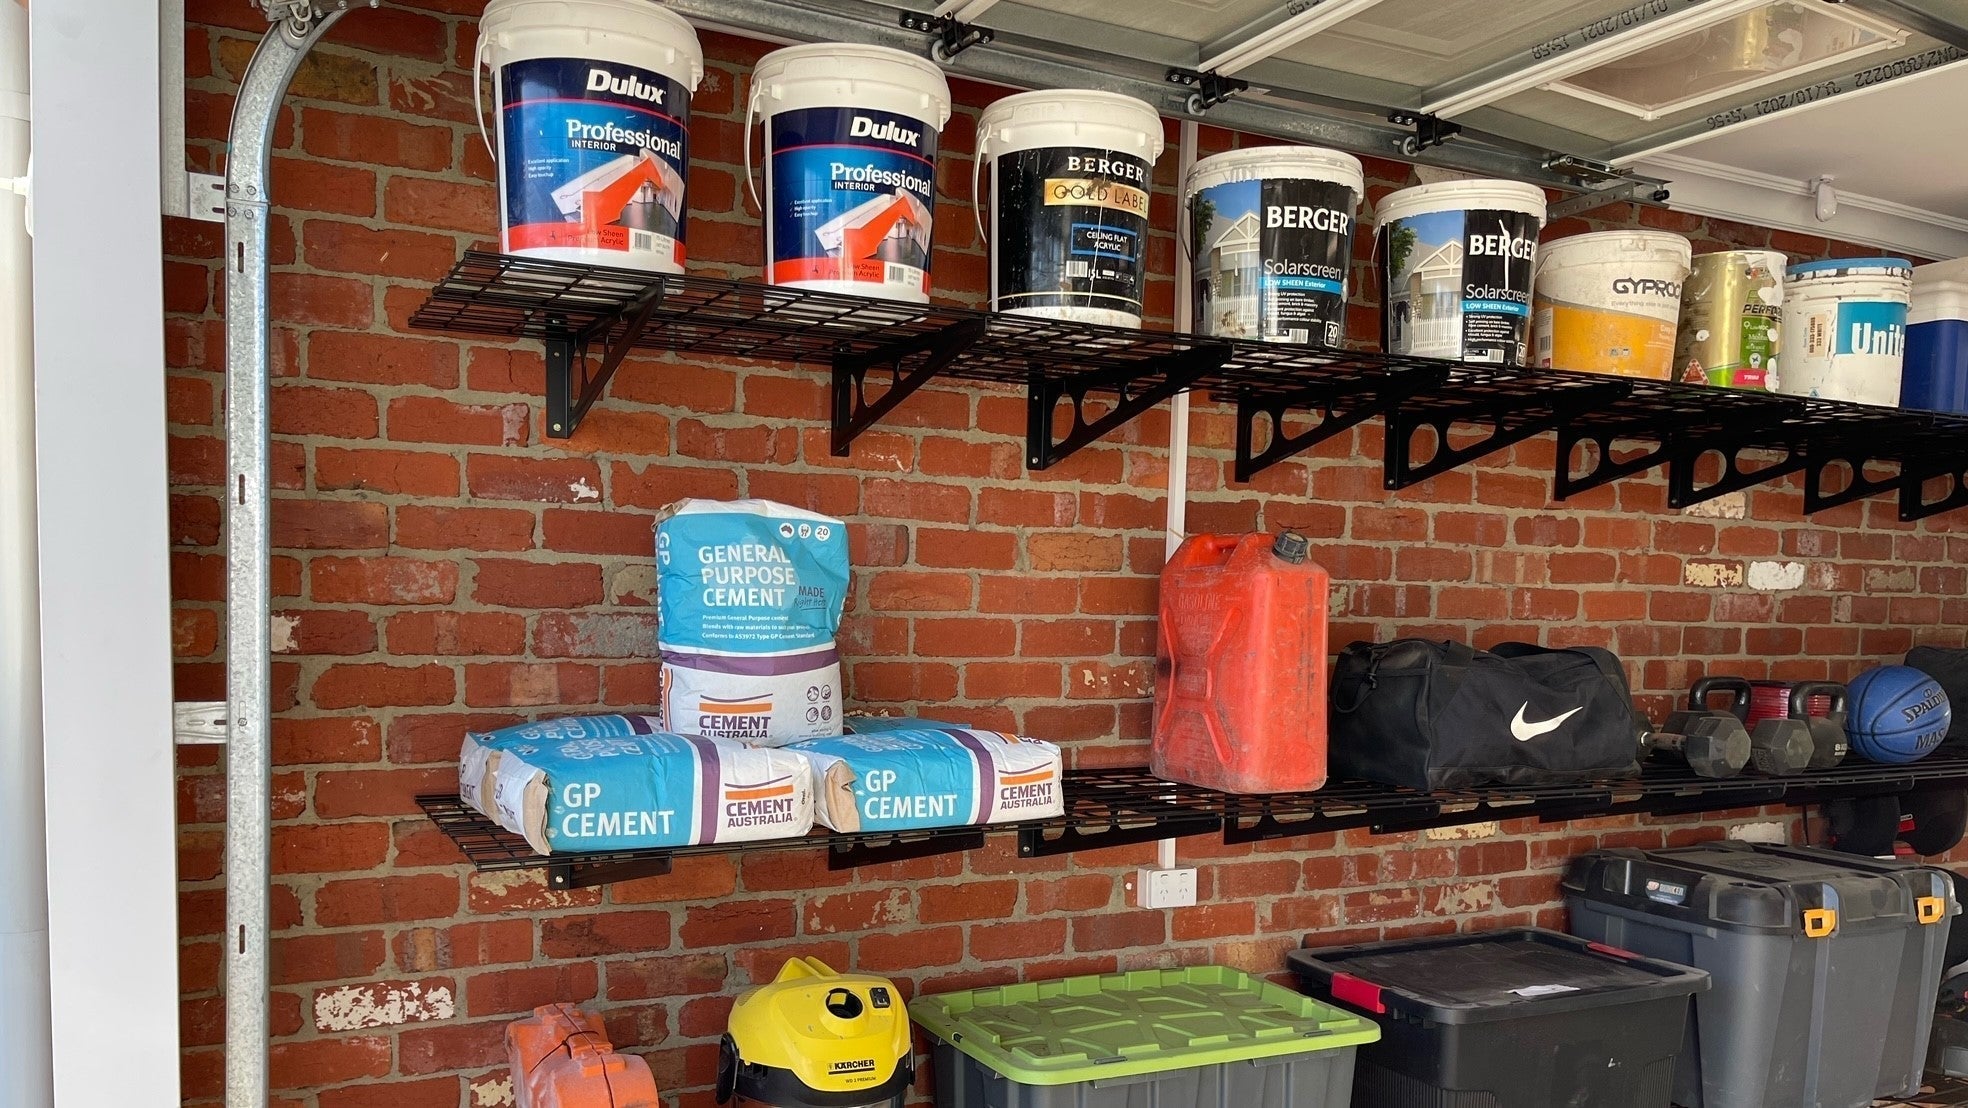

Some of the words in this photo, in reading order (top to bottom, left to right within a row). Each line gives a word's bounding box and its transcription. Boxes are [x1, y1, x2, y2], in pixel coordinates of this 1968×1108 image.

[586, 68, 664, 105] Dulux
[566, 118, 681, 160] Professional
[850, 116, 919, 147] Dulux
[571, 139, 617, 152] INTERIOR
[1067, 156, 1144, 183] BERGER
[830, 162, 931, 198] Professional
[834, 181, 876, 192] INTERIOR
[1053, 184, 1108, 201] GOLD
[1114, 188, 1147, 214] LABEL
[1266, 205, 1349, 236] BERGER
[601, 236, 624, 246] Acrylic
[603, 229, 623, 238] Sheen
[1086, 231, 1113, 241] CEILING
[1114, 235, 1128, 243] FLAT
[1094, 241, 1121, 252] ACRYLIC
[1469, 234, 1537, 263] BERGER
[860, 263, 880, 271] Sheen
[1264, 258, 1342, 280] Solarscreen
[1264, 279, 1281, 287] LOW
[1282, 279, 1304, 287] SHEEN
[1304, 280, 1326, 289] Exterior
[1465, 283, 1530, 304] Solarscreen
[1465, 302, 1481, 310] LOW
[1482, 302, 1501, 310] SHEEN
[1501, 304, 1519, 312] Exterior
[1328, 324, 1338, 338] 20
[817, 527, 829, 536] 20
[657, 531, 671, 566] GP
[698, 544, 791, 564] GENERAL
[701, 566, 796, 586] PURPOSE
[703, 588, 785, 607] CEMENT
[798, 586, 825, 598] MADE
[699, 715, 771, 730] CEMENT
[865, 769, 897, 792] GP
[563, 782, 601, 808] GP
[1000, 783, 1053, 801] CEMENT
[726, 798, 794, 817] CEMENT
[864, 794, 958, 820] CEMENT
[1000, 795, 1053, 810] AUSTRALIA
[562, 810, 674, 838] CEMENT
[727, 812, 793, 828] AUSTRALIA
